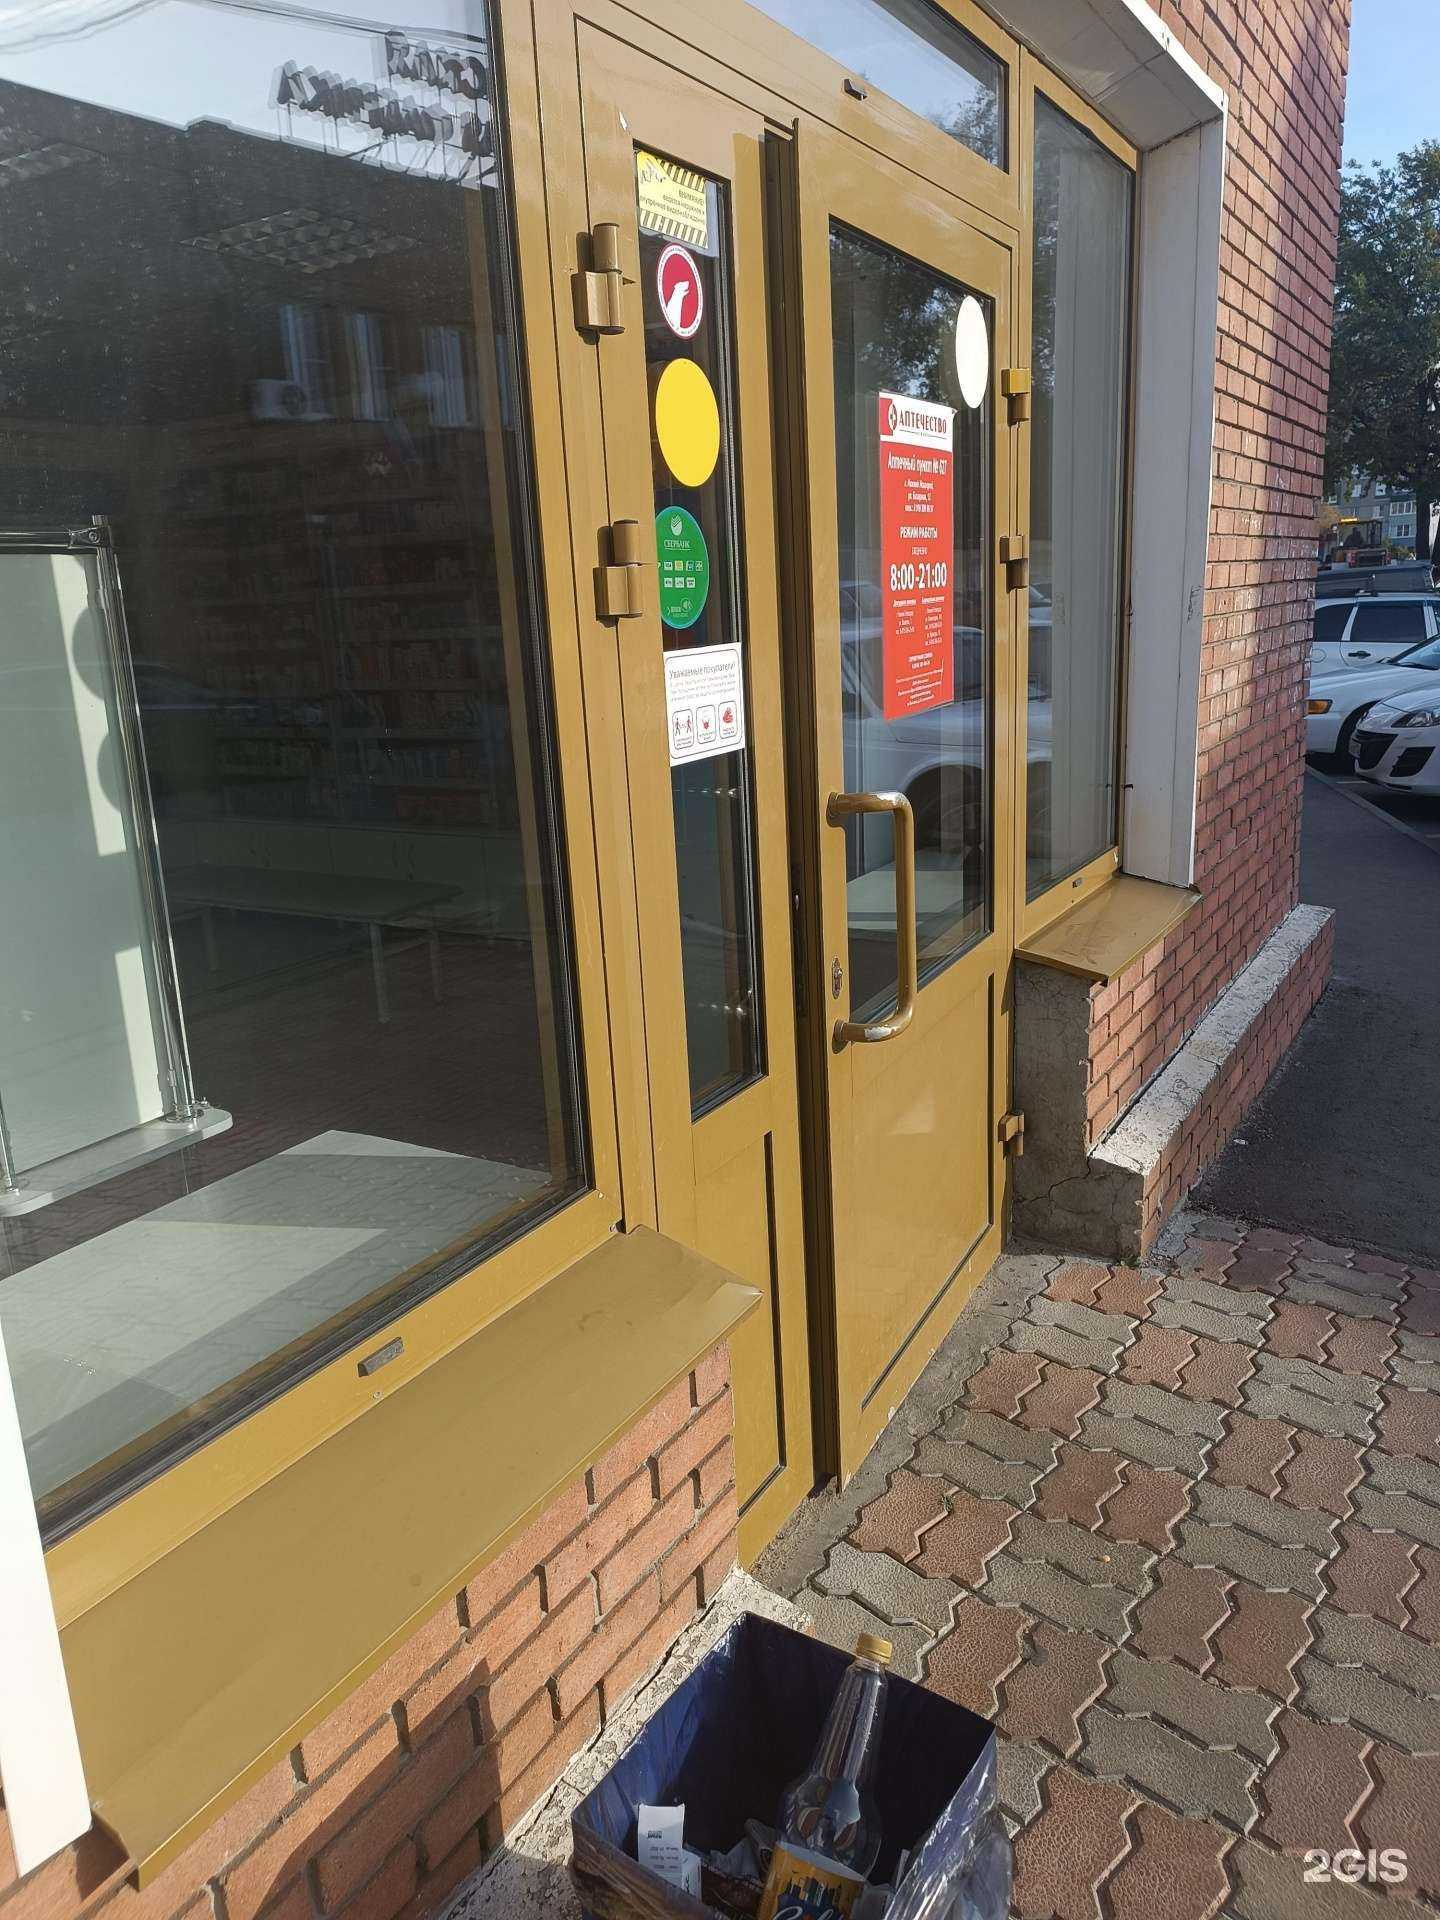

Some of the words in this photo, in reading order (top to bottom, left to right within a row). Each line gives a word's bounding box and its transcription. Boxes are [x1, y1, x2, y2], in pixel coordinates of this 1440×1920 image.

[899, 409, 947, 434] АПТЕЧЕСТВО
[888, 452, 916, 471] Аптечный
[900, 526, 918, 539] РЕЖИМ
[919, 526, 938, 539] РАБОТЫ
[890, 562, 947, 592] 8:00-21:00
[669, 667, 703, 680] Уважаемые
